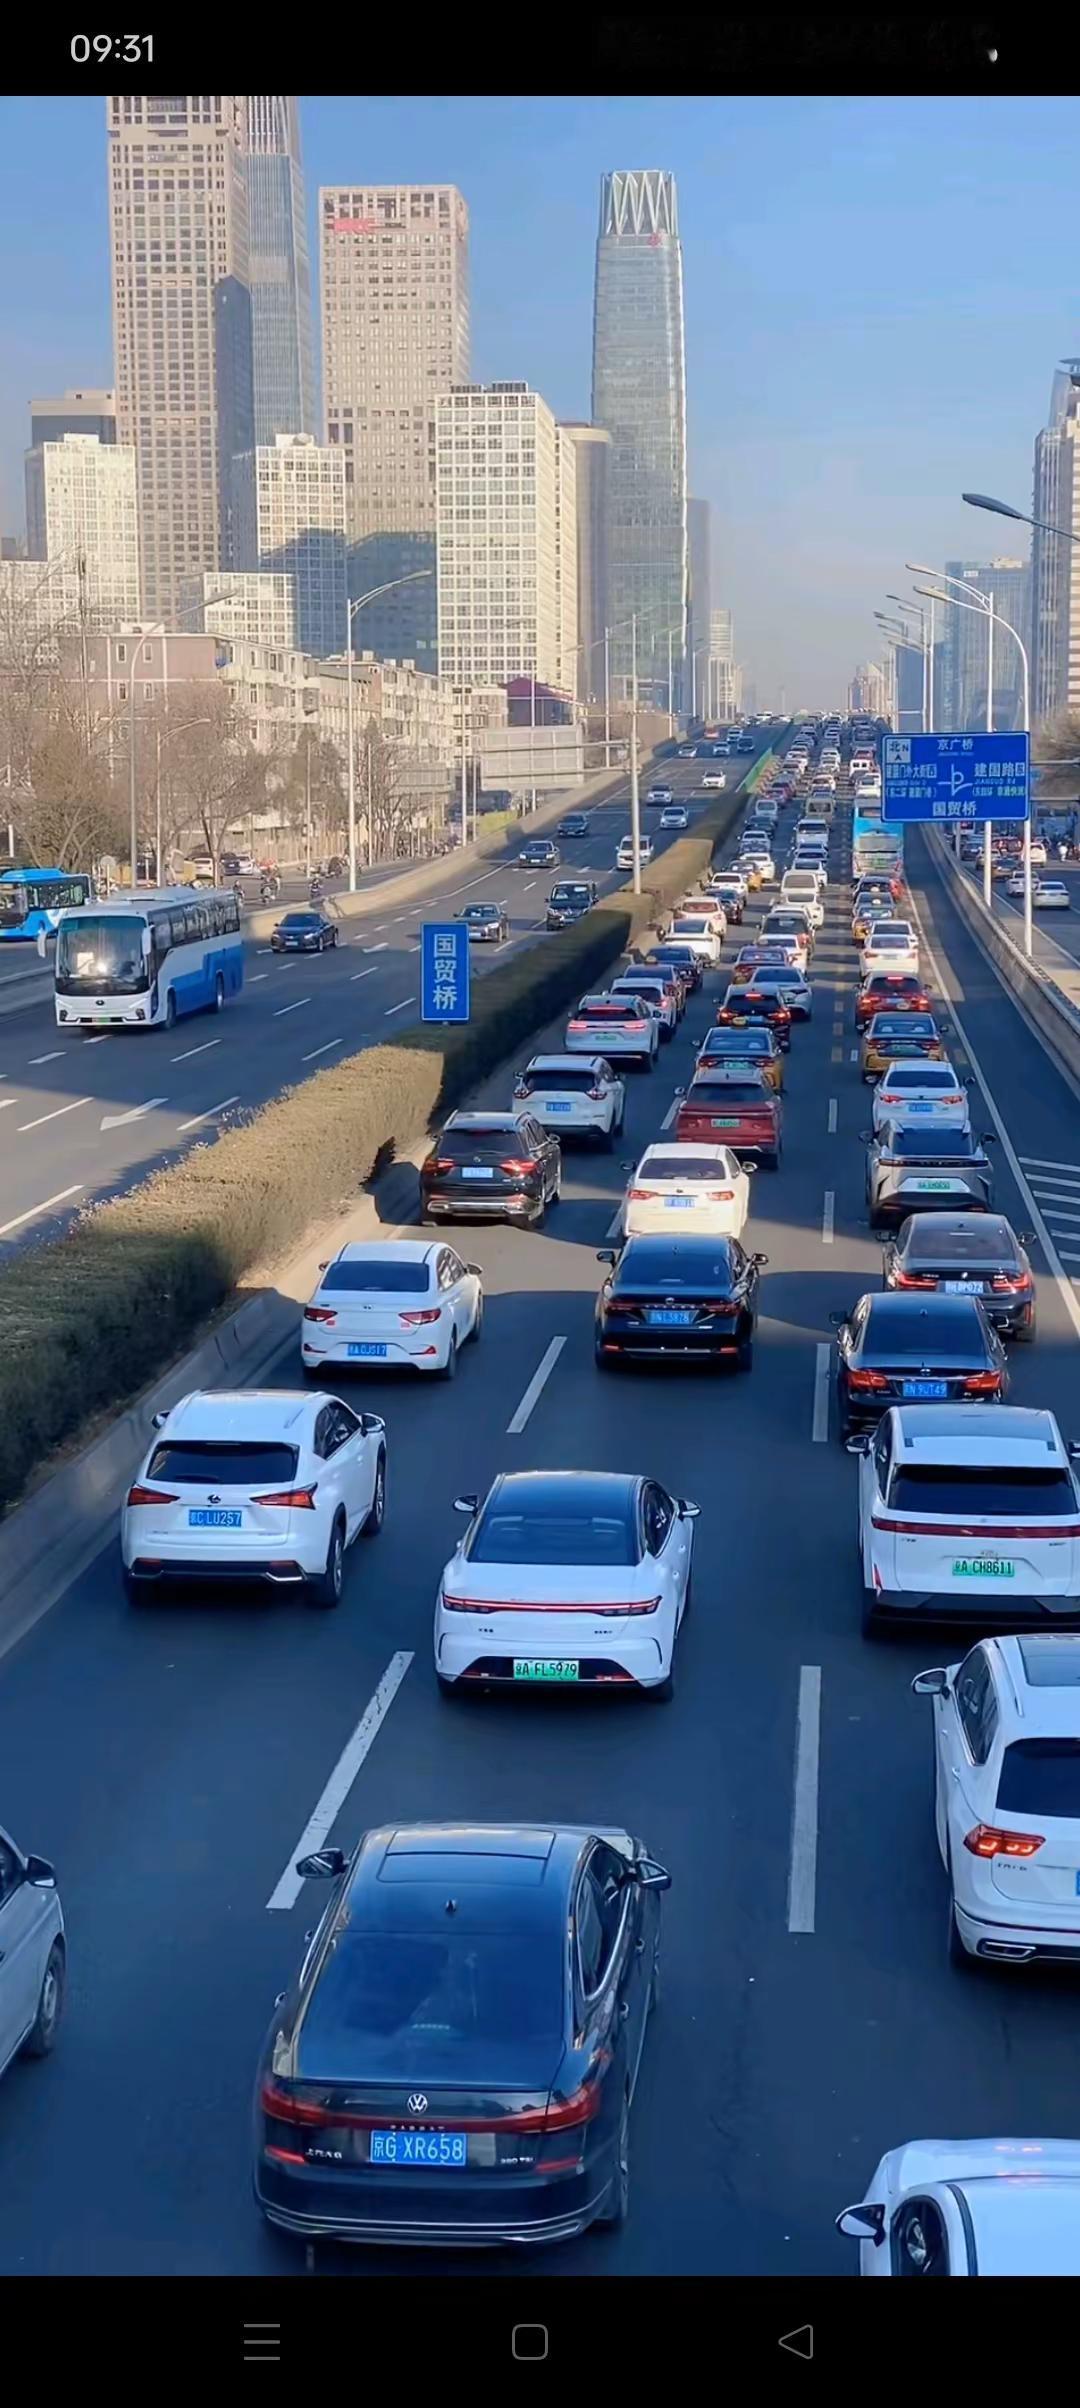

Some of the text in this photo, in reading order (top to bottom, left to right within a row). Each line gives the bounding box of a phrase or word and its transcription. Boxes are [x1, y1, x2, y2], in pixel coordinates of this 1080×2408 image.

[937, 738, 974, 750] 京广桥
[886, 764, 937, 778] 门外大街
[933, 801, 978, 816] 国贸桥
[433, 933, 457, 1010] 国贸桥
